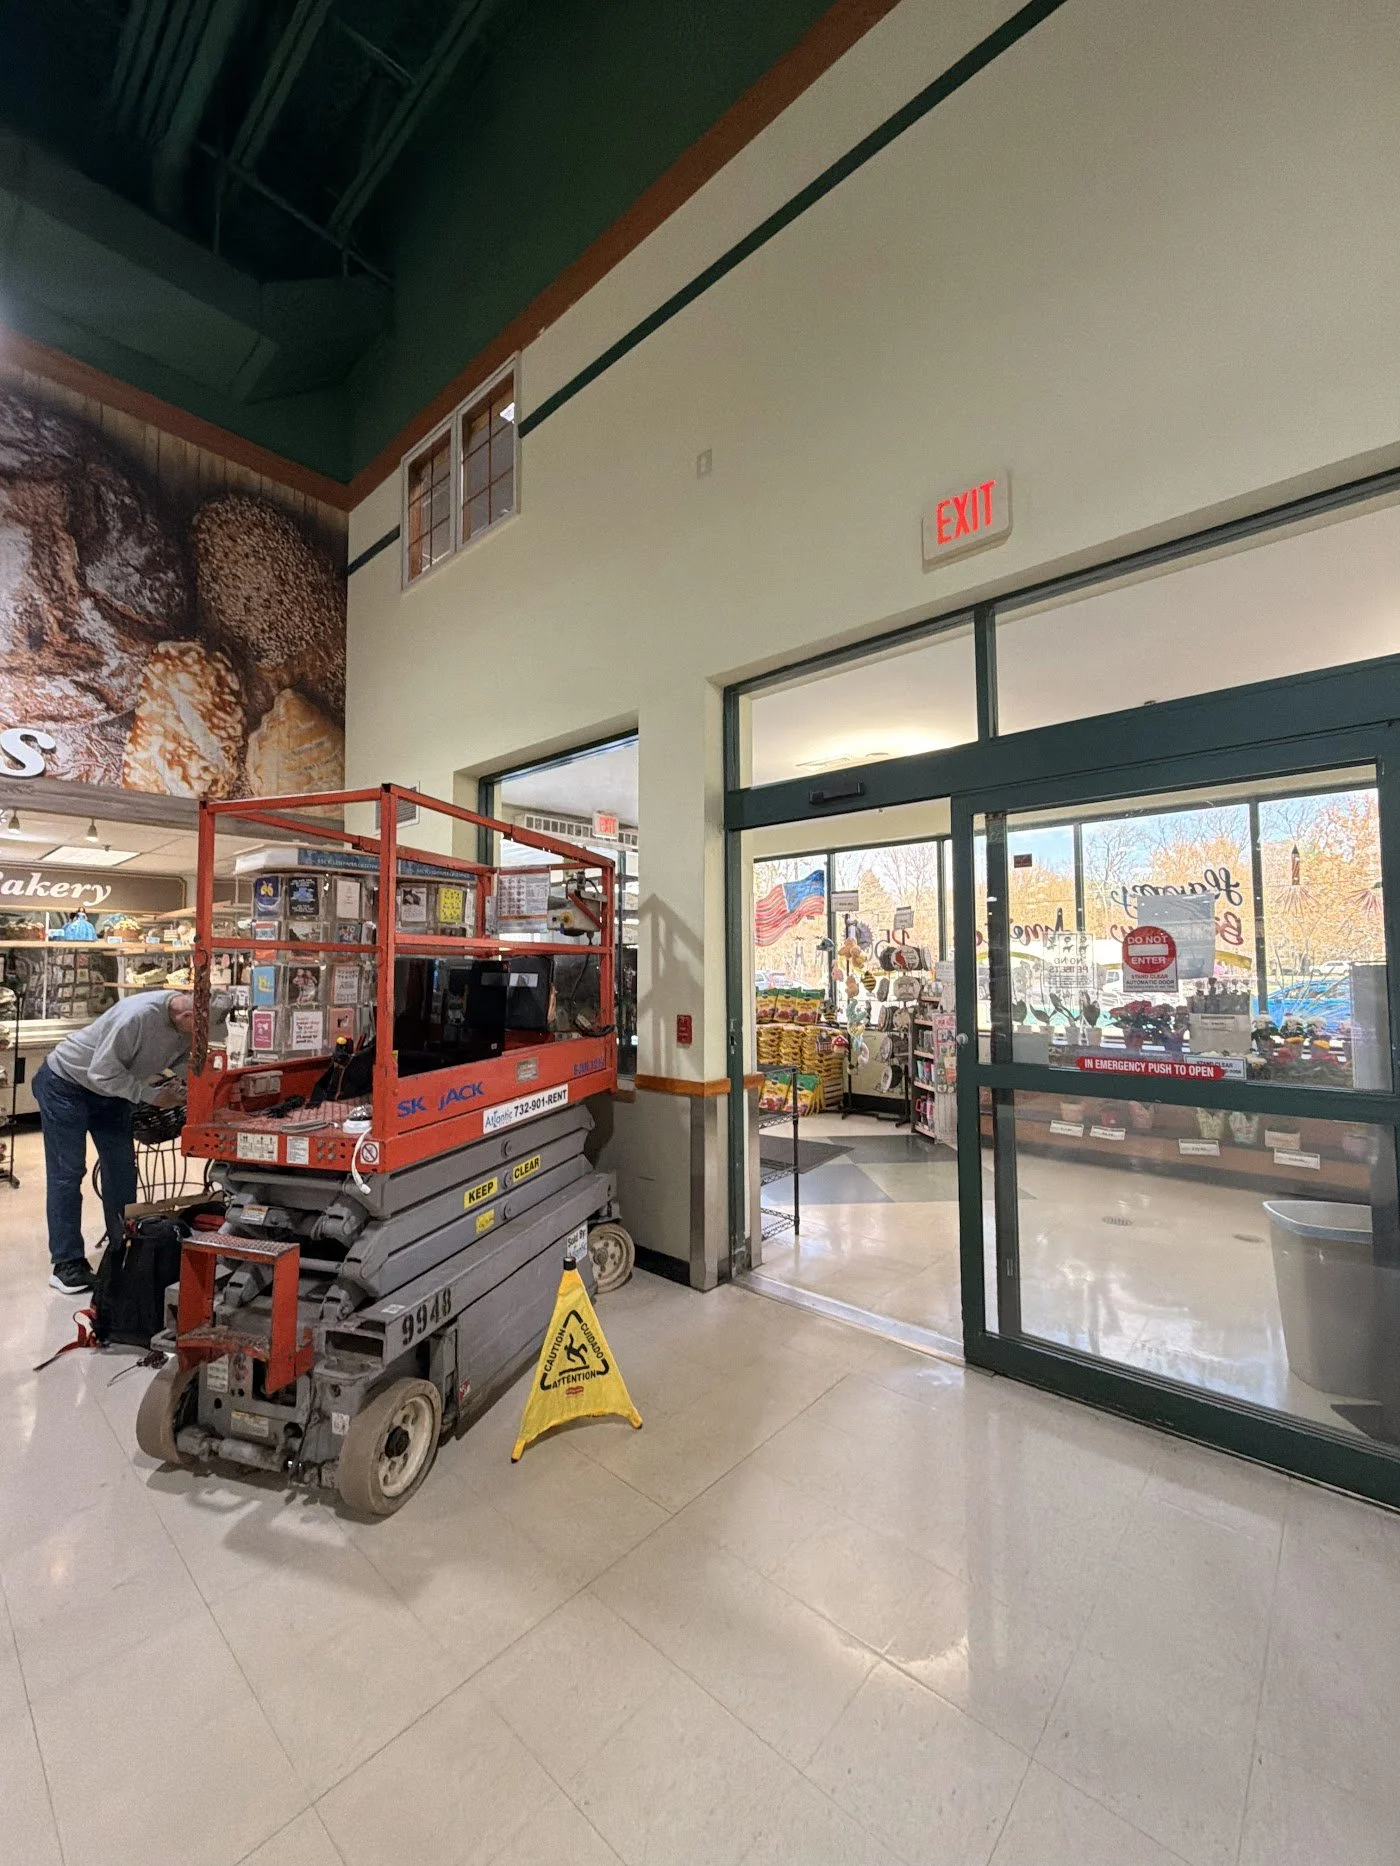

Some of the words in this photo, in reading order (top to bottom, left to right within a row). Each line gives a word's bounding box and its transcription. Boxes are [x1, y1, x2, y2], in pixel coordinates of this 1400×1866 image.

[936, 480, 997, 545] EXIT
[598, 815, 617, 834] EXIT
[0, 872, 112, 907] akery
[1127, 936, 1144, 944] DO
[1145, 935, 1168, 944] NOT
[1131, 956, 1166, 965] ENTER
[1084, 1058, 1093, 1069] IN
[1095, 1059, 1146, 1073] EMERGENCY
[1148, 1063, 1172, 1075] PUSH
[1174, 1064, 1187, 1076] TO
[1188, 1065, 1214, 1078] OPEN
[514, 1089, 567, 1117] 732-901-RENT
[468, 1181, 494, 1203] KEEP
[514, 1157, 540, 1179] CLEAR
[402, 1288, 451, 1345] 9948
[544, 1328, 566, 1372] CAUTION
[580, 1323, 604, 1359] CUIDADO
[552, 1369, 596, 1389] ATTENTION
